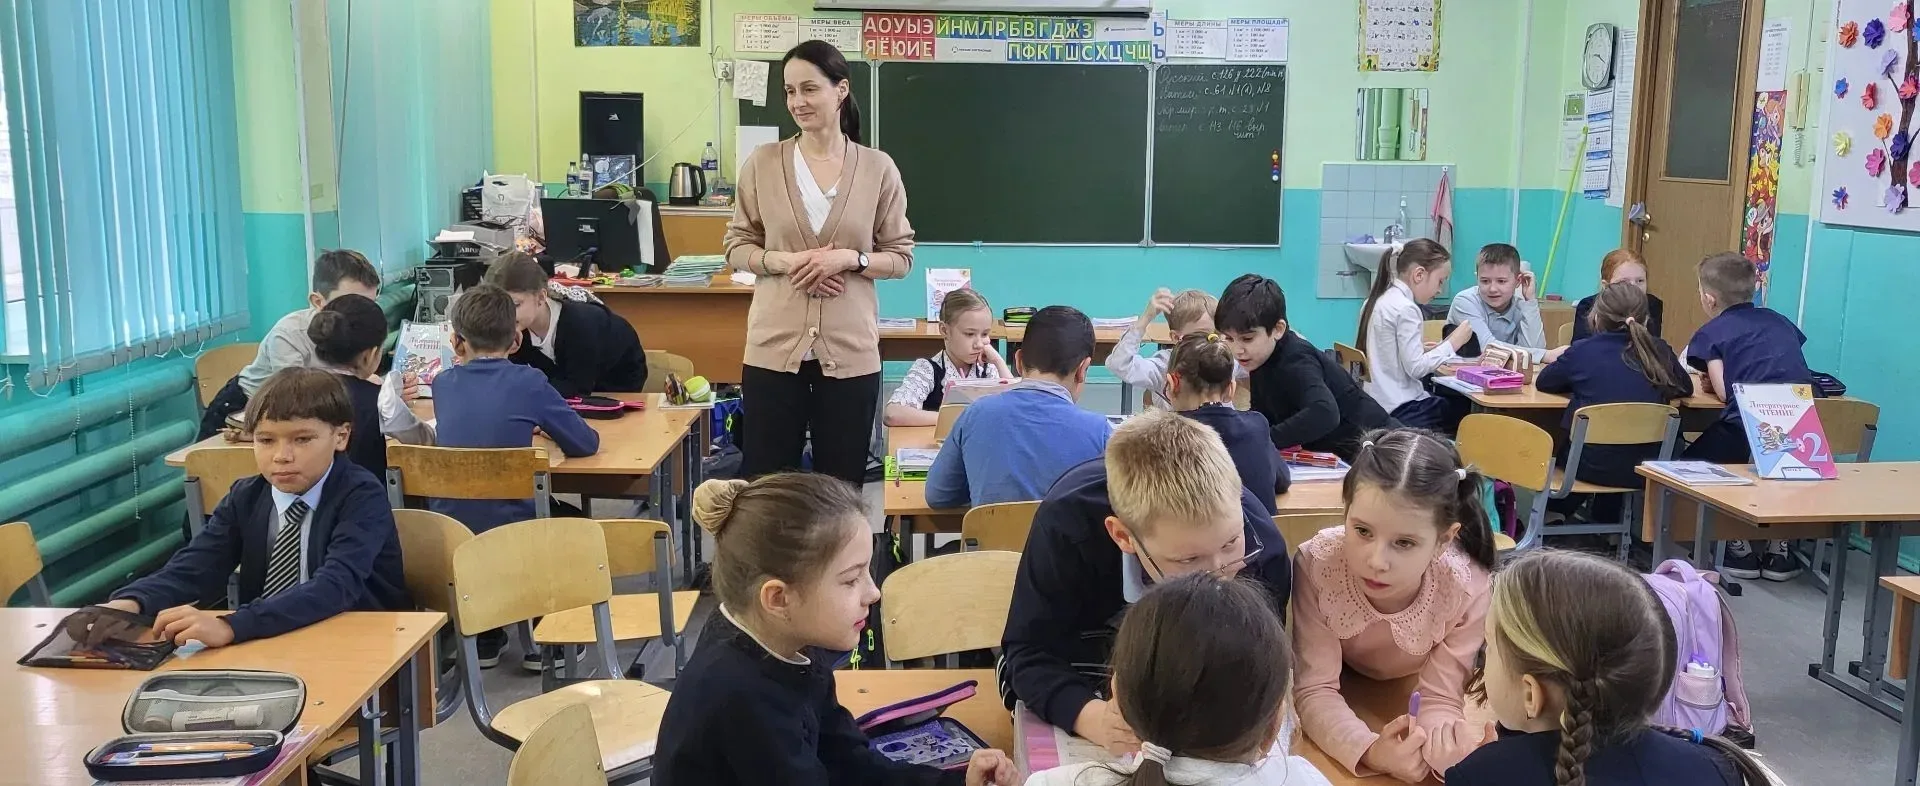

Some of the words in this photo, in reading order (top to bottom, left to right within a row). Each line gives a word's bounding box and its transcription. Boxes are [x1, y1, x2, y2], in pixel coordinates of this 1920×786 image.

[1749, 401, 1799, 410] Литературное
[1759, 409, 1795, 417] ЧТЕНИЕ
[1802, 432, 1828, 462] 2
